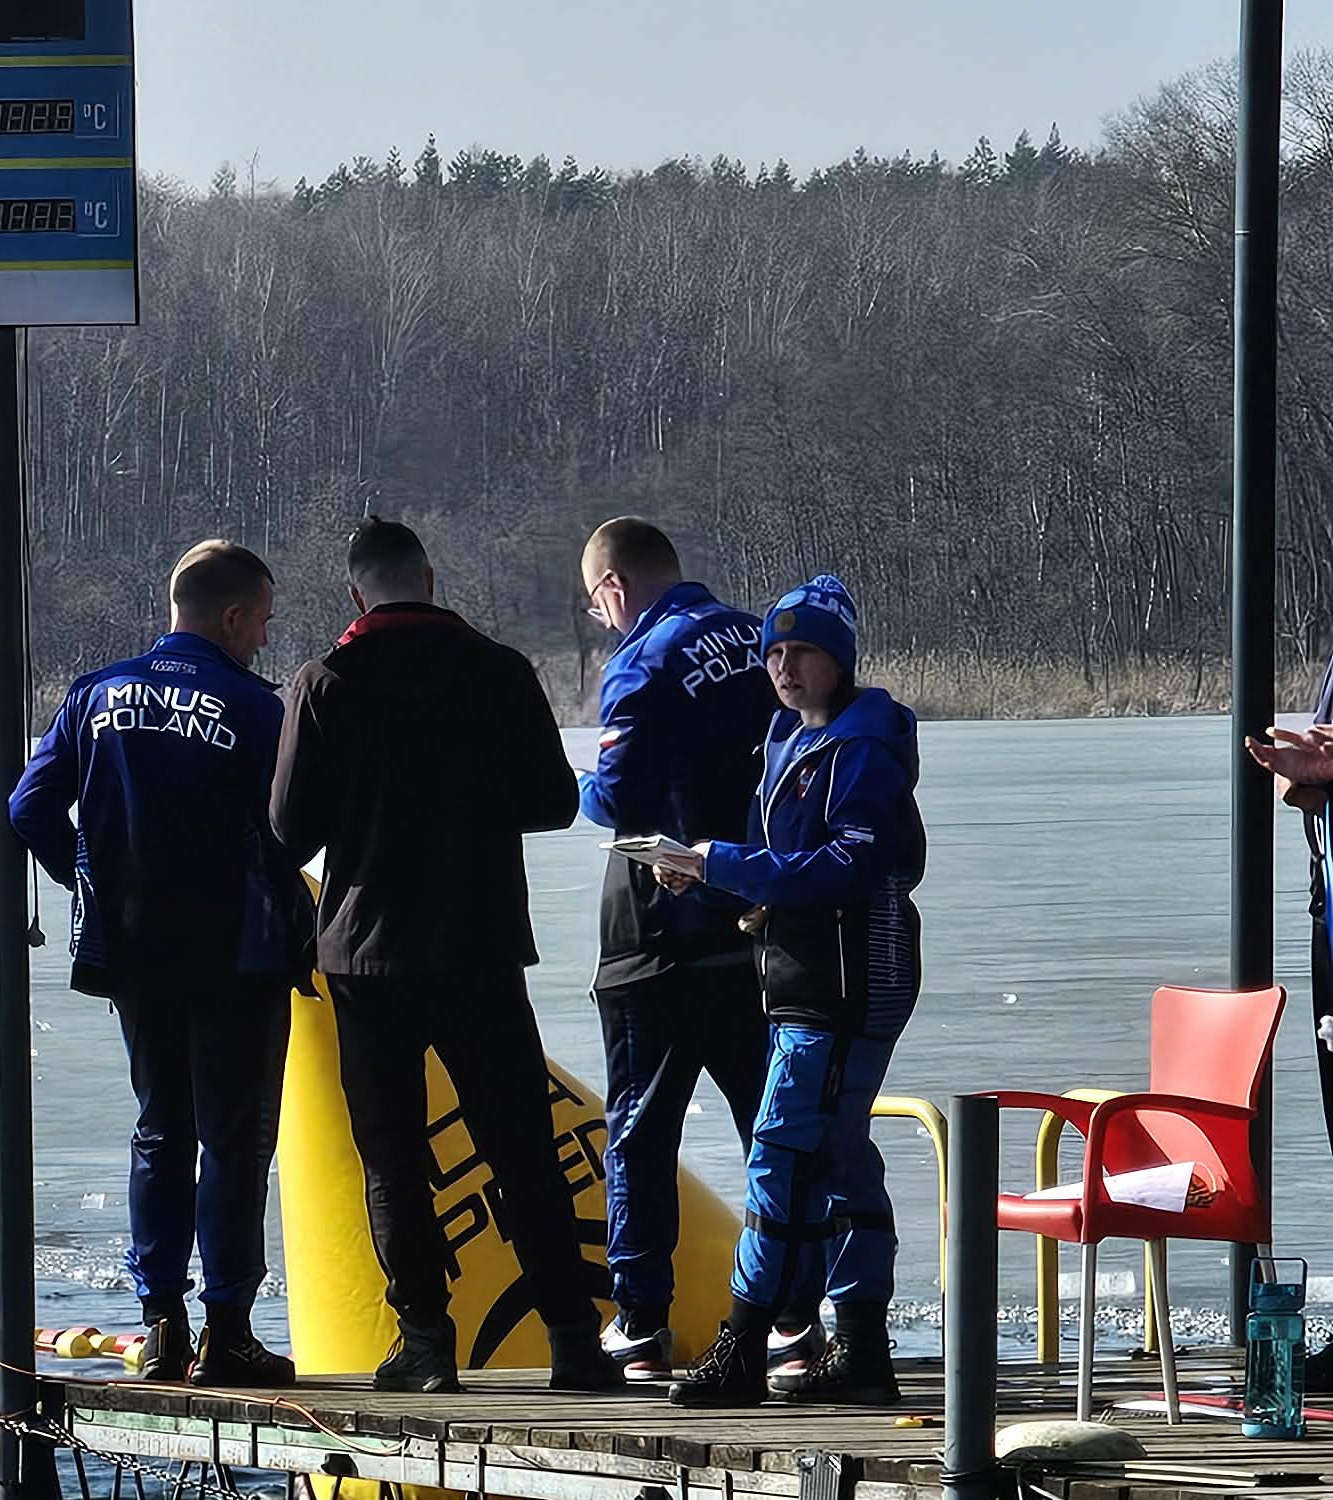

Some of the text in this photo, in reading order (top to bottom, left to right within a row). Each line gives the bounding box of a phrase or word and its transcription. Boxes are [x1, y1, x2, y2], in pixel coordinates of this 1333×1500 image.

[682, 624, 762, 665] MINU
[107, 683, 226, 719] MINUS
[90, 707, 237, 750] POLAND
